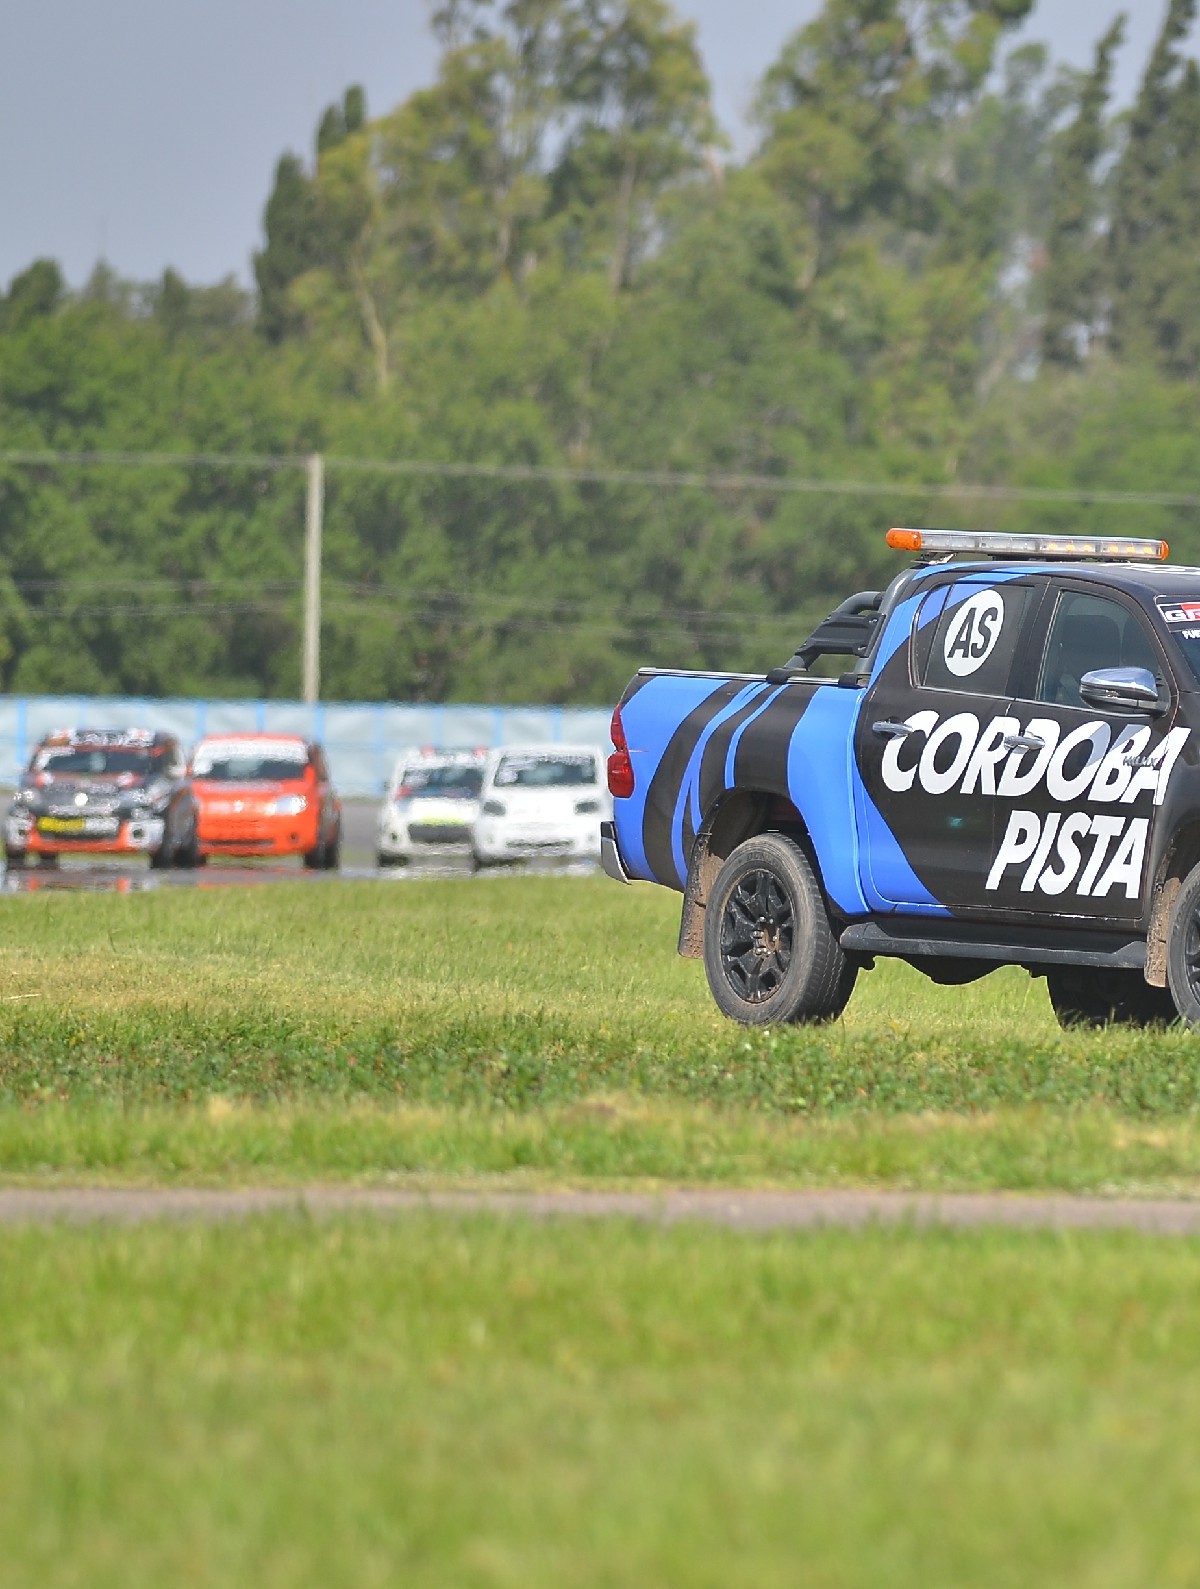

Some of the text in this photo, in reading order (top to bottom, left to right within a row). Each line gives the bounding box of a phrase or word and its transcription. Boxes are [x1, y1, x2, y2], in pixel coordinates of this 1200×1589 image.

[947, 606, 998, 659] AS
[881, 710, 1192, 806] CORDOBA
[985, 810, 1149, 899] PISTA
